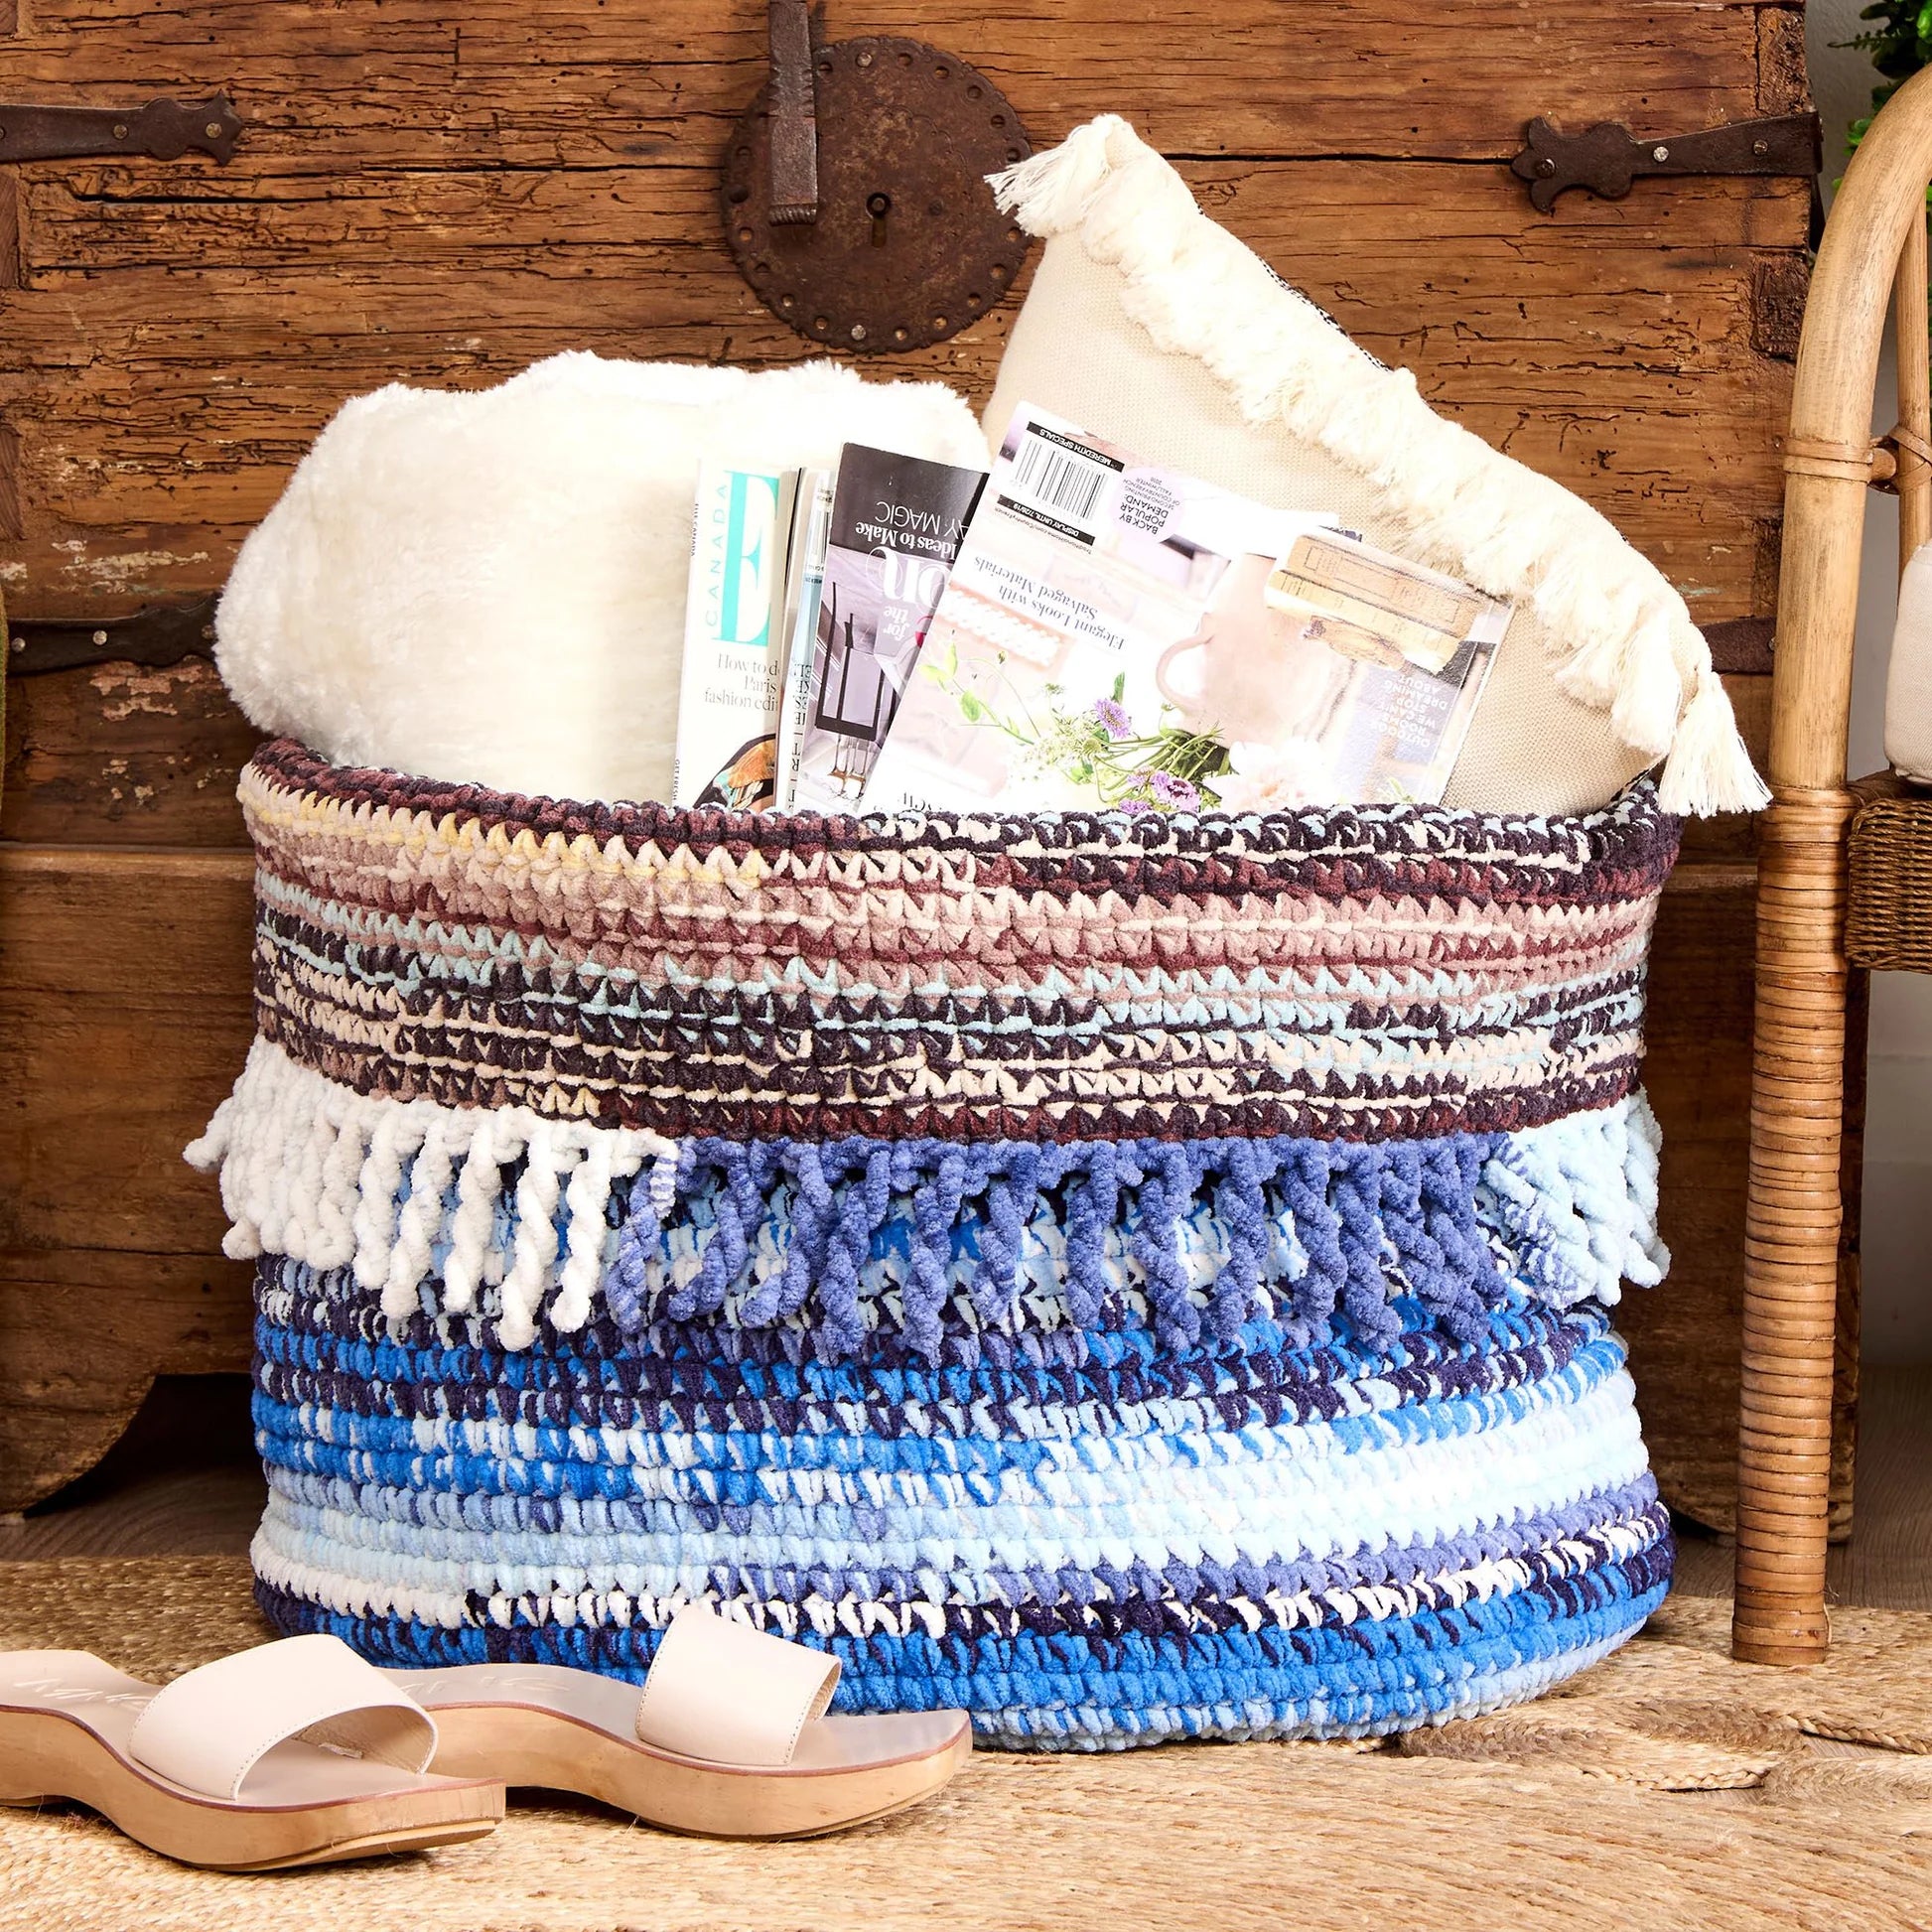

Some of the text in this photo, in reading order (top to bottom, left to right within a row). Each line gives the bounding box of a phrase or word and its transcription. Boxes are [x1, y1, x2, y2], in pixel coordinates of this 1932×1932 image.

[1039, 428, 1112, 466] MEREDITH SPECIALS
[855, 501, 898, 547] Make
[875, 501, 940, 535] MAGIC
[1035, 513, 1053, 526] UNTIL
[1119, 513, 1158, 534] BACK BY
[1120, 502, 1166, 527] POPULAR
[900, 532, 915, 549] to
[1052, 521, 1079, 537] DISPLAY
[705, 484, 727, 626] CANADA
[711, 471, 779, 647] E
[917, 536, 957, 560] Ideas
[974, 556, 1098, 620] Salvaged Materials
[884, 606, 909, 623] the
[999, 585, 1125, 650] Elegant Looks with
[883, 621, 909, 640] for
[717, 652, 750, 672] How
[753, 661, 766, 674] to
[745, 675, 776, 694] Paris
[1383, 680, 1448, 711] DREAMING
[704, 687, 752, 708] fashion
[1396, 697, 1428, 714] STOP
